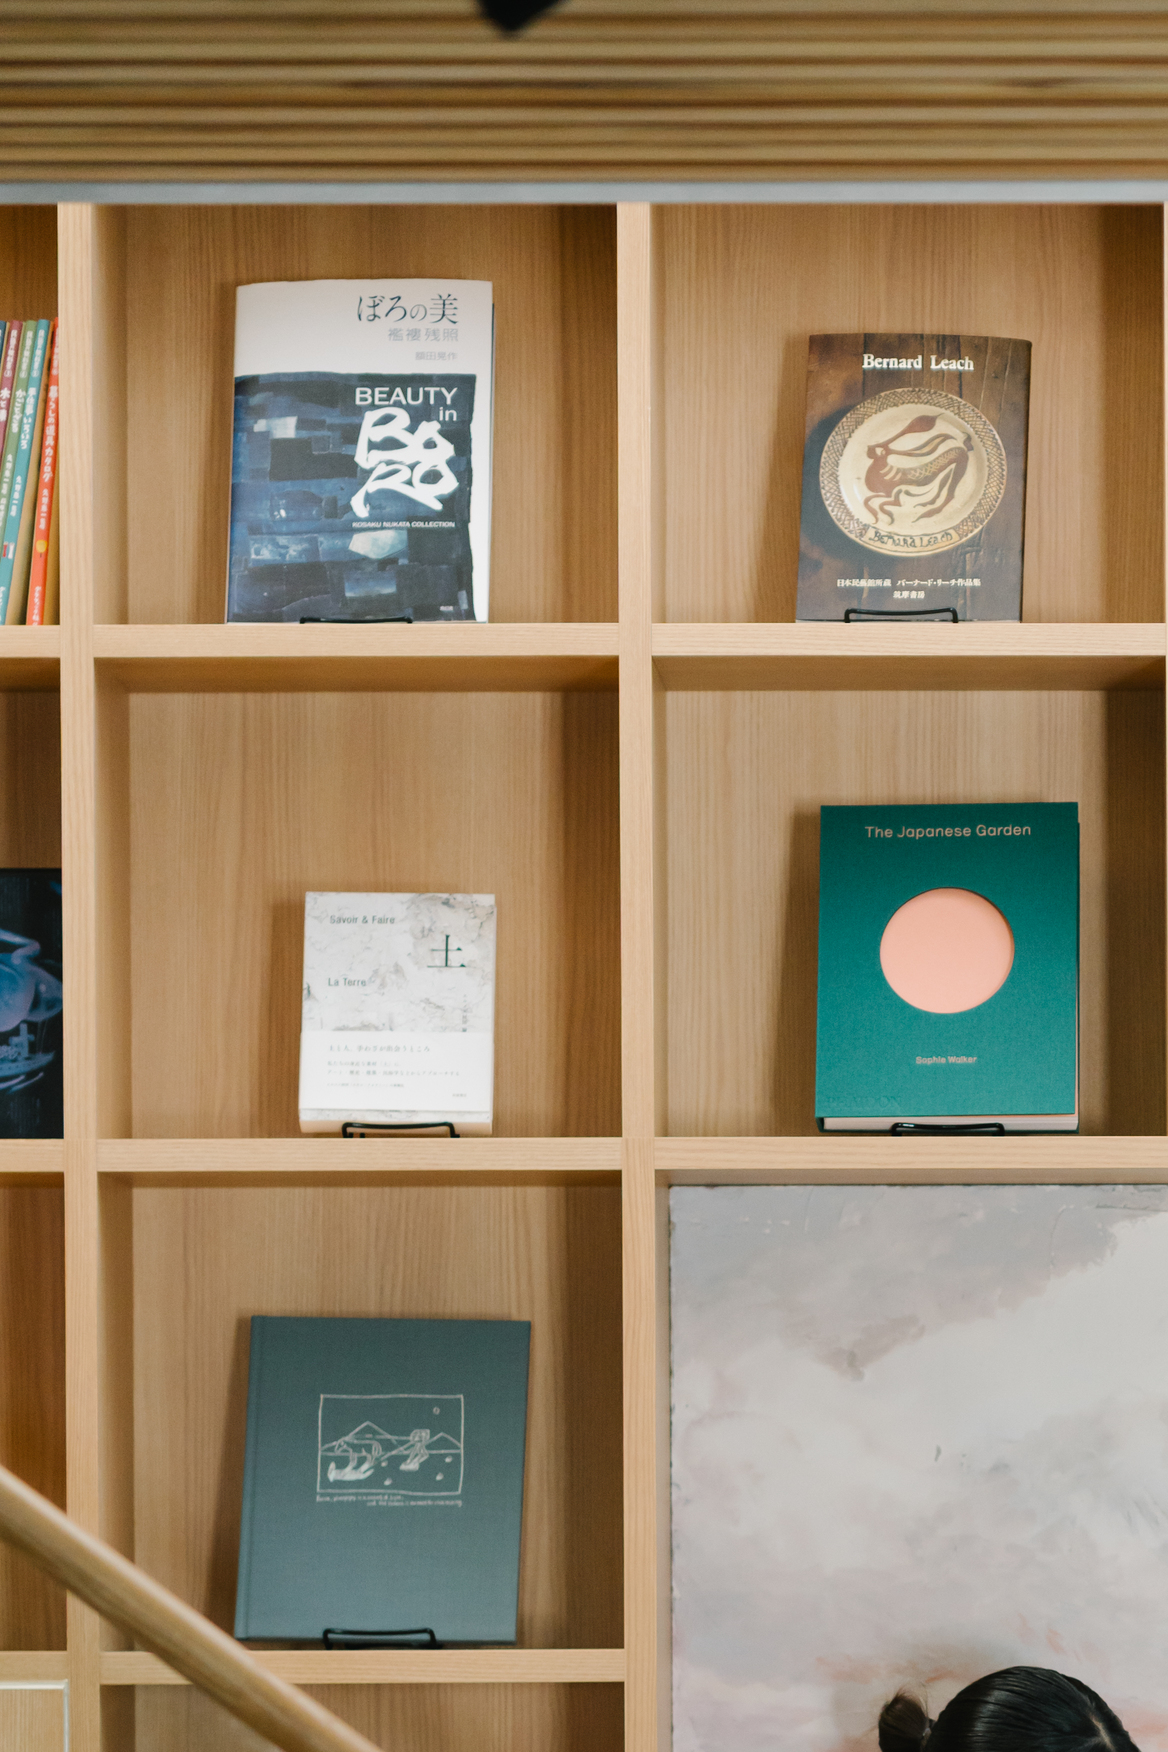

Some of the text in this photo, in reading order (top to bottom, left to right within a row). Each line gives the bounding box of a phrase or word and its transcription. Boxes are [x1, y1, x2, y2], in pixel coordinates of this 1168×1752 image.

[357, 293, 459, 325] ぼろの美
[862, 353, 975, 371] Bernard Leach
[355, 387, 458, 405] BEAUTY
[438, 406, 458, 422] in
[411, 520, 456, 528] COLLECTION
[865, 824, 1032, 840] The Japanese Garden
[329, 915, 396, 925] Savoir & Faire
[427, 934, 467, 968] 土
[328, 978, 367, 987] La Terre
[915, 1055, 978, 1066] Sophie Walker
